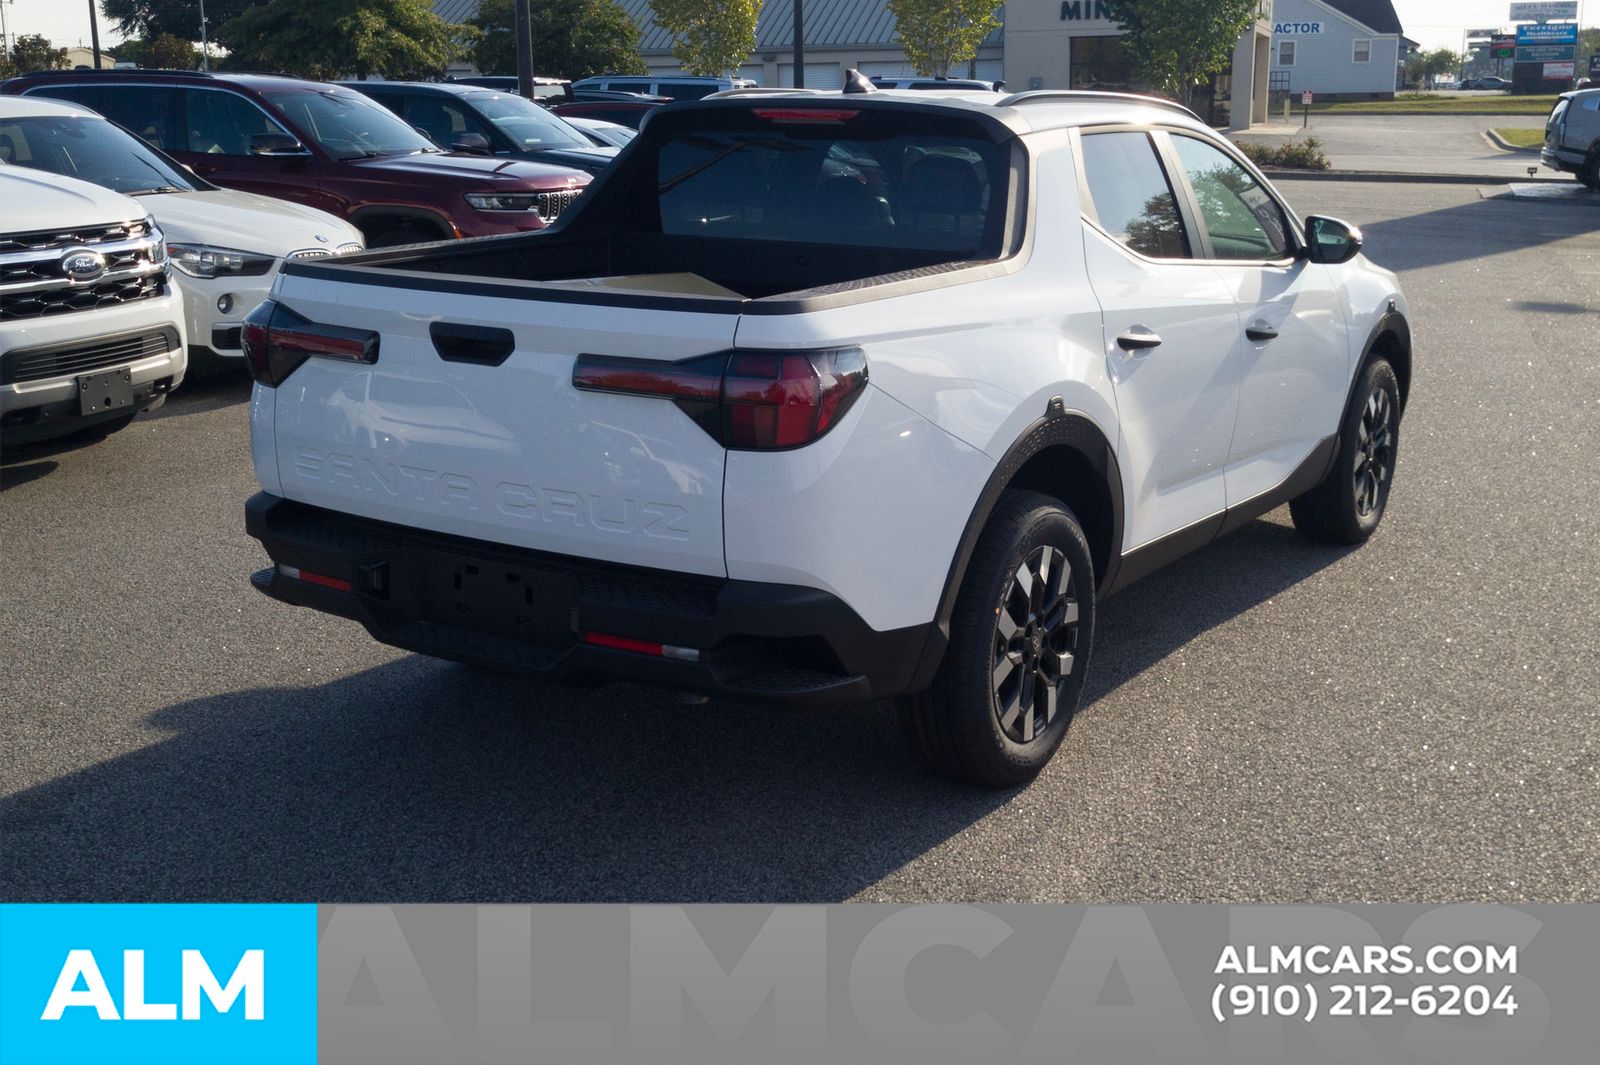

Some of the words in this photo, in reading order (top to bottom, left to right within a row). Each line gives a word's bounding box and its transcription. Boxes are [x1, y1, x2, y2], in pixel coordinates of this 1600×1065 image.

[1272, 22, 1320, 34] ACTOR
[295, 446, 479, 511] SANTA
[496, 481, 690, 541] CRUZ
